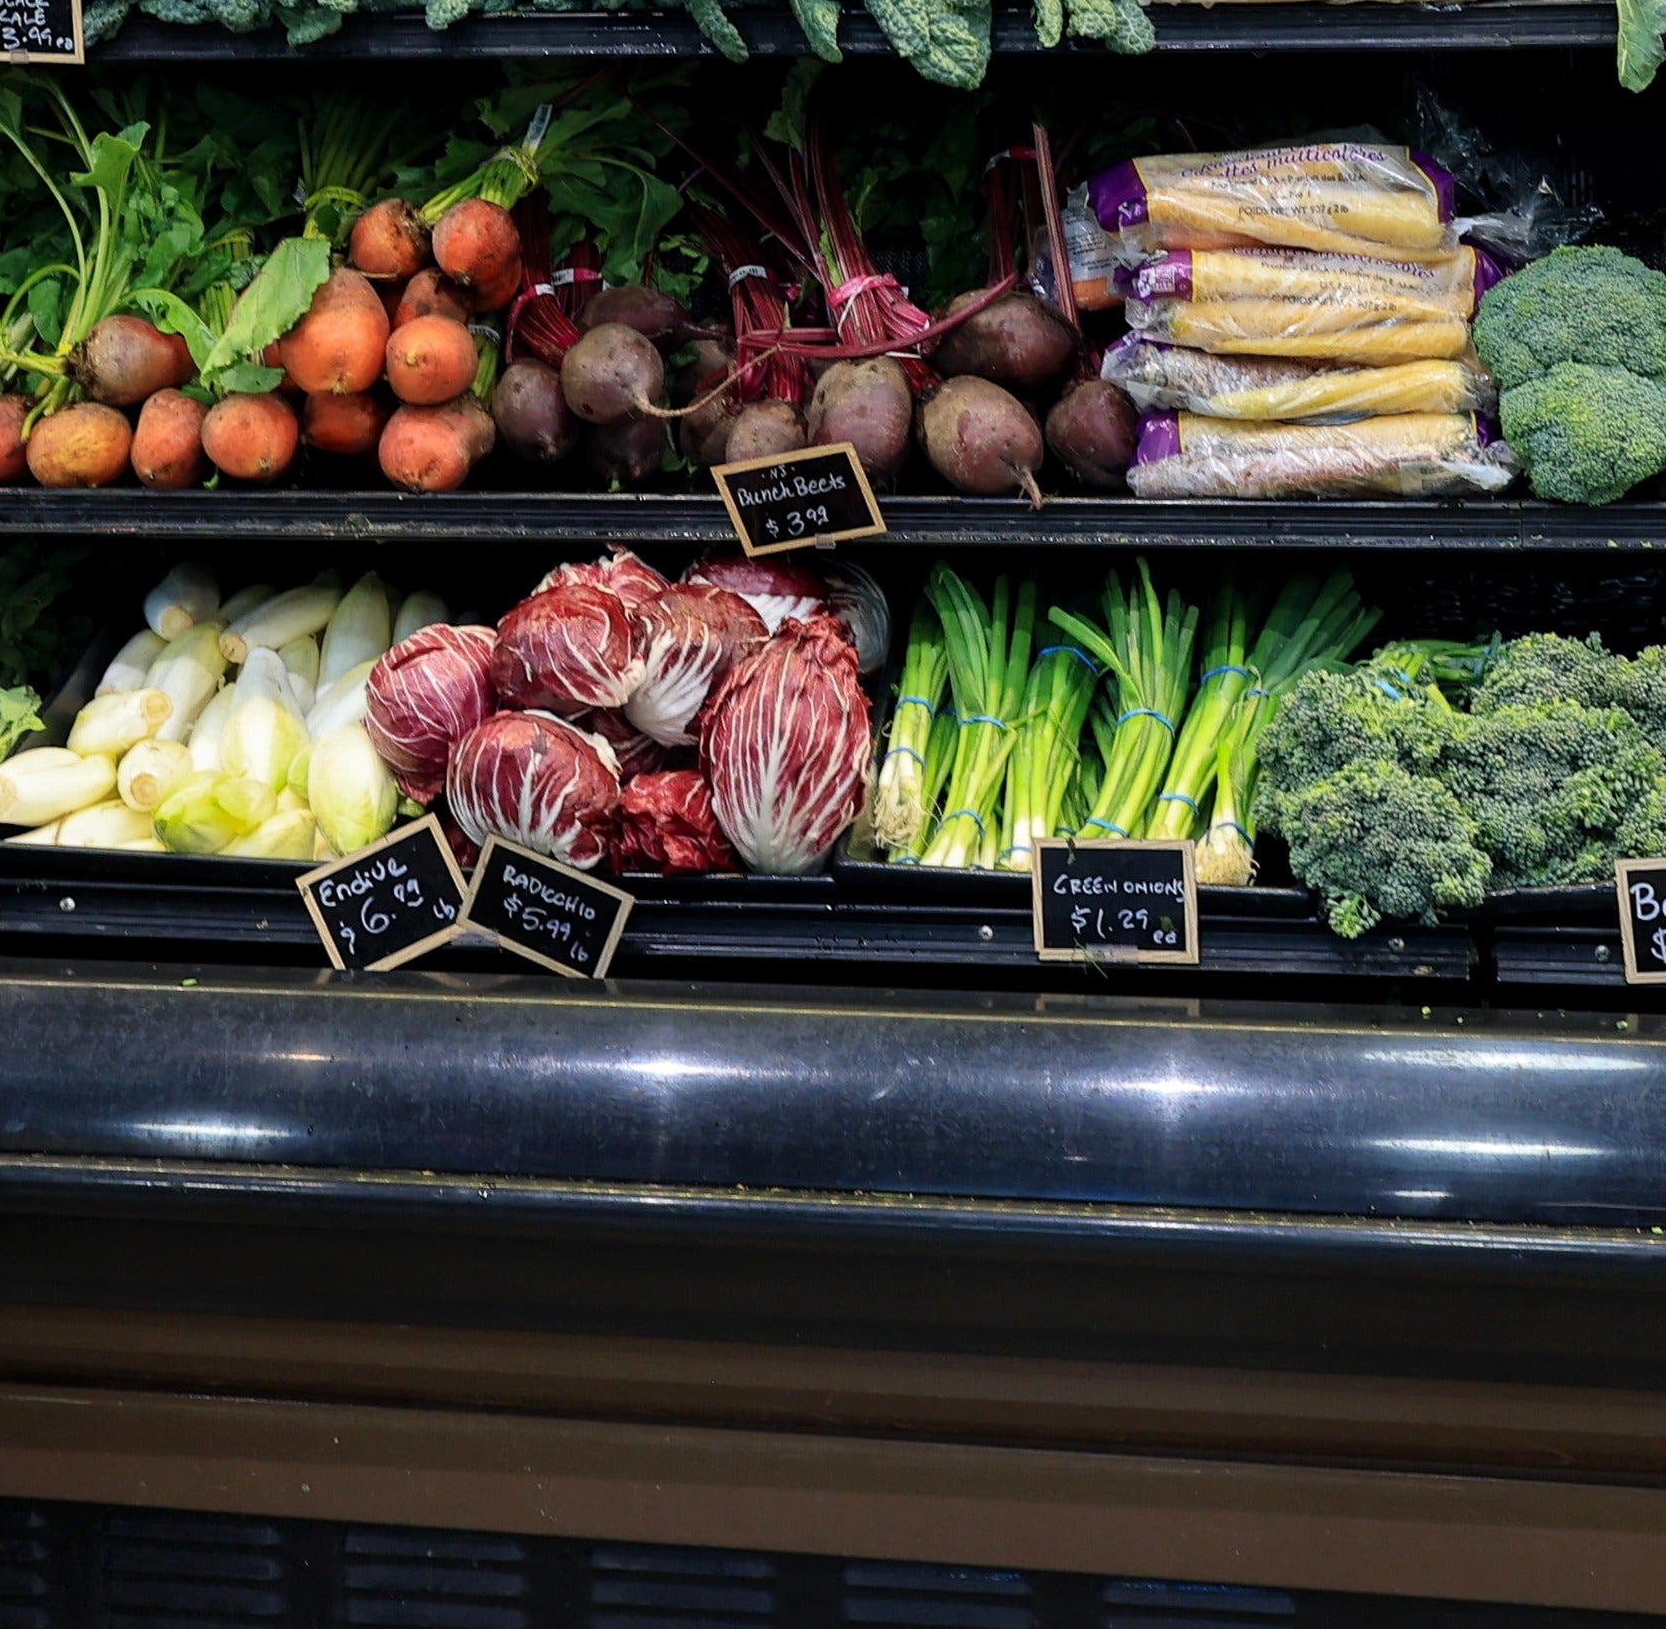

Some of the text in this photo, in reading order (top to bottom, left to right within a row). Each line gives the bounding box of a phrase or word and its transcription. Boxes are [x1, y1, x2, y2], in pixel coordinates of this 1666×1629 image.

[736, 472, 847, 508] Bunch Beets
[319, 857, 408, 908] Endive
[1052, 873, 1185, 904] GREEN ONIONS
[503, 896, 589, 962] $5.99 lb
[1069, 904, 1178, 945] $1.29 ea
